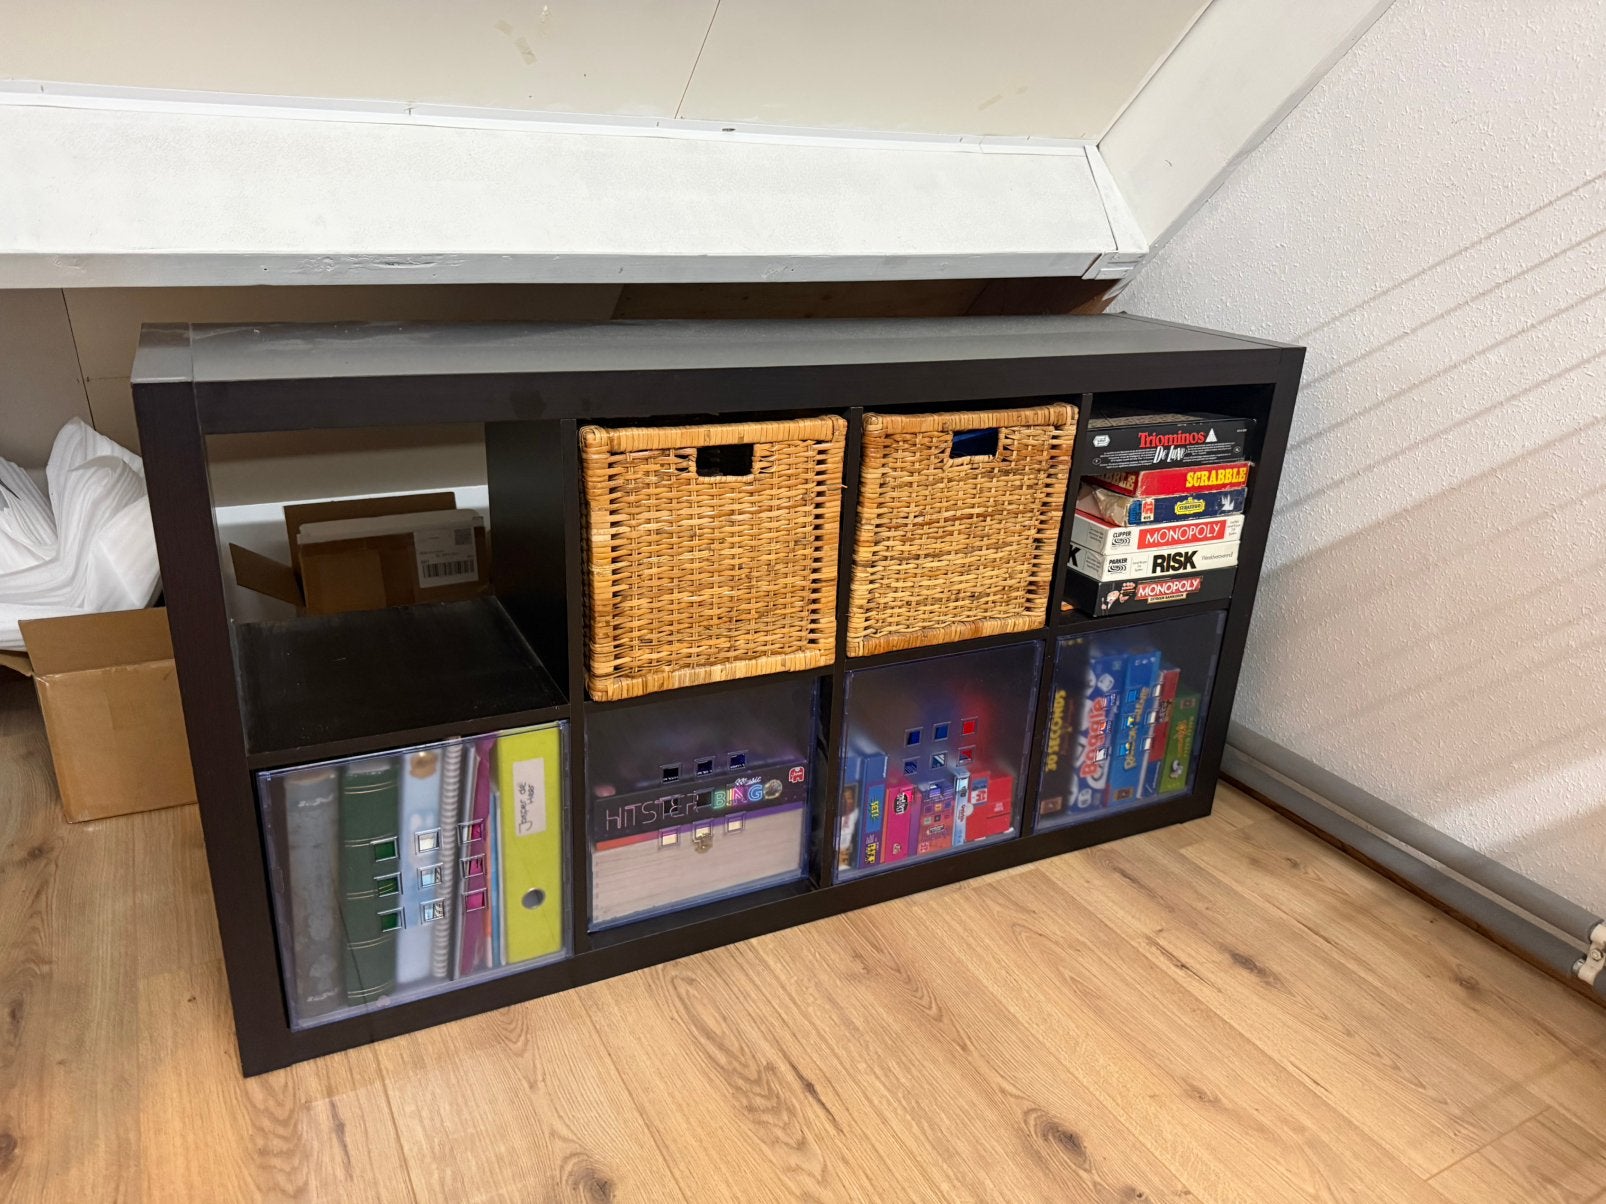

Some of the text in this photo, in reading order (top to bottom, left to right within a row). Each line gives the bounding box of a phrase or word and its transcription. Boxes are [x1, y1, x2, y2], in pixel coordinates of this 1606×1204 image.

[1138, 430, 1206, 448] Triominos
[1153, 445, 1167, 464] De
[1167, 445, 1188, 463] Luxe
[1185, 466, 1248, 488] SCRABBLE
[1145, 522, 1222, 545] MONOPOLY
[1109, 557, 1128, 565] PARKER
[1151, 550, 1200, 574] RISK
[1137, 578, 1201, 597] MONOPOLY
[1047, 689, 1067, 753] SECONDS
[1079, 696, 1107, 778] Boggle
[713, 778, 784, 809] BINGO
